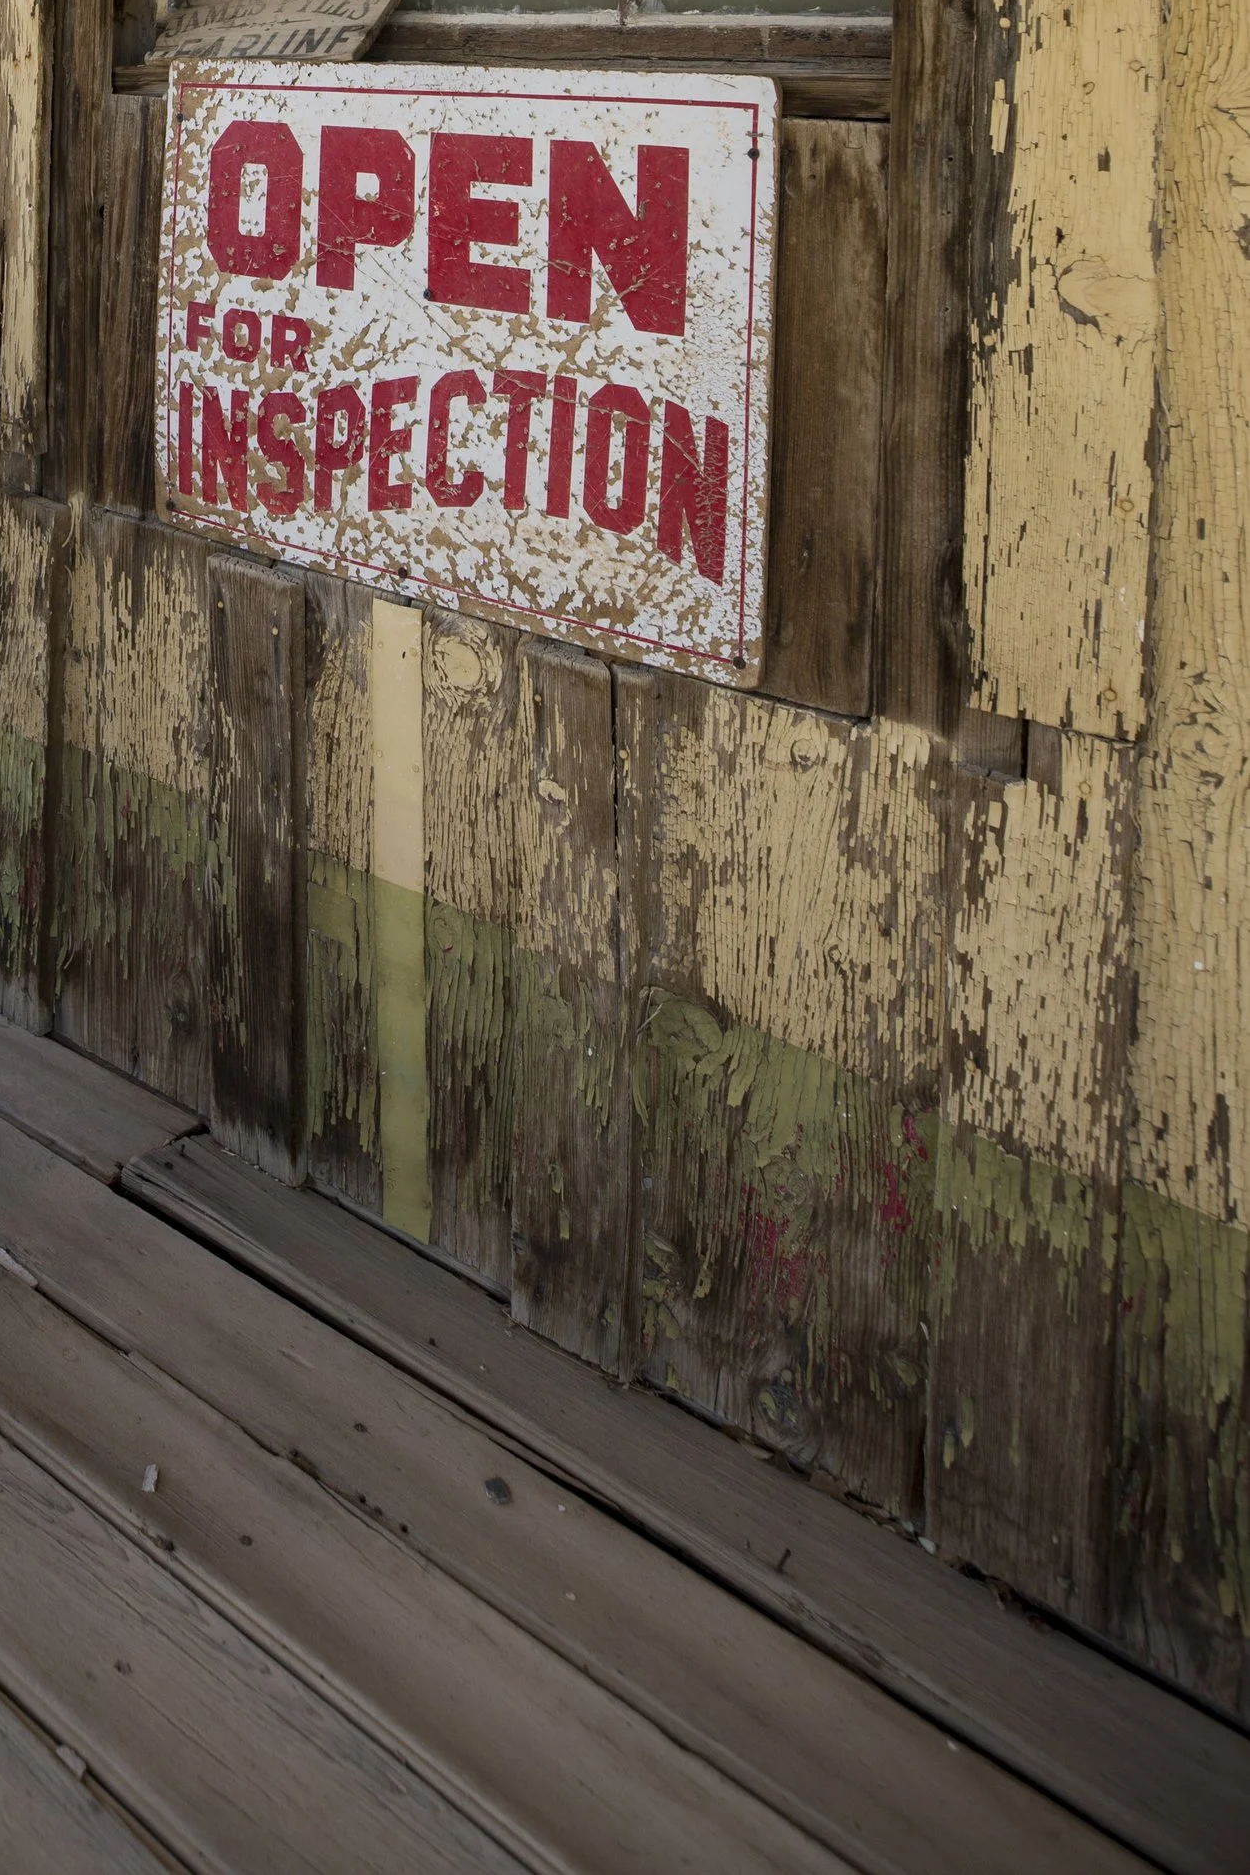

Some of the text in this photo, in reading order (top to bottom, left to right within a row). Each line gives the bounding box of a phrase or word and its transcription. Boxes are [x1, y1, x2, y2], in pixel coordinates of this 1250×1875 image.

[186, 300, 312, 373] FOR
[207, 120, 690, 337] OPEN
[177, 369, 729, 587] INSPECTION
